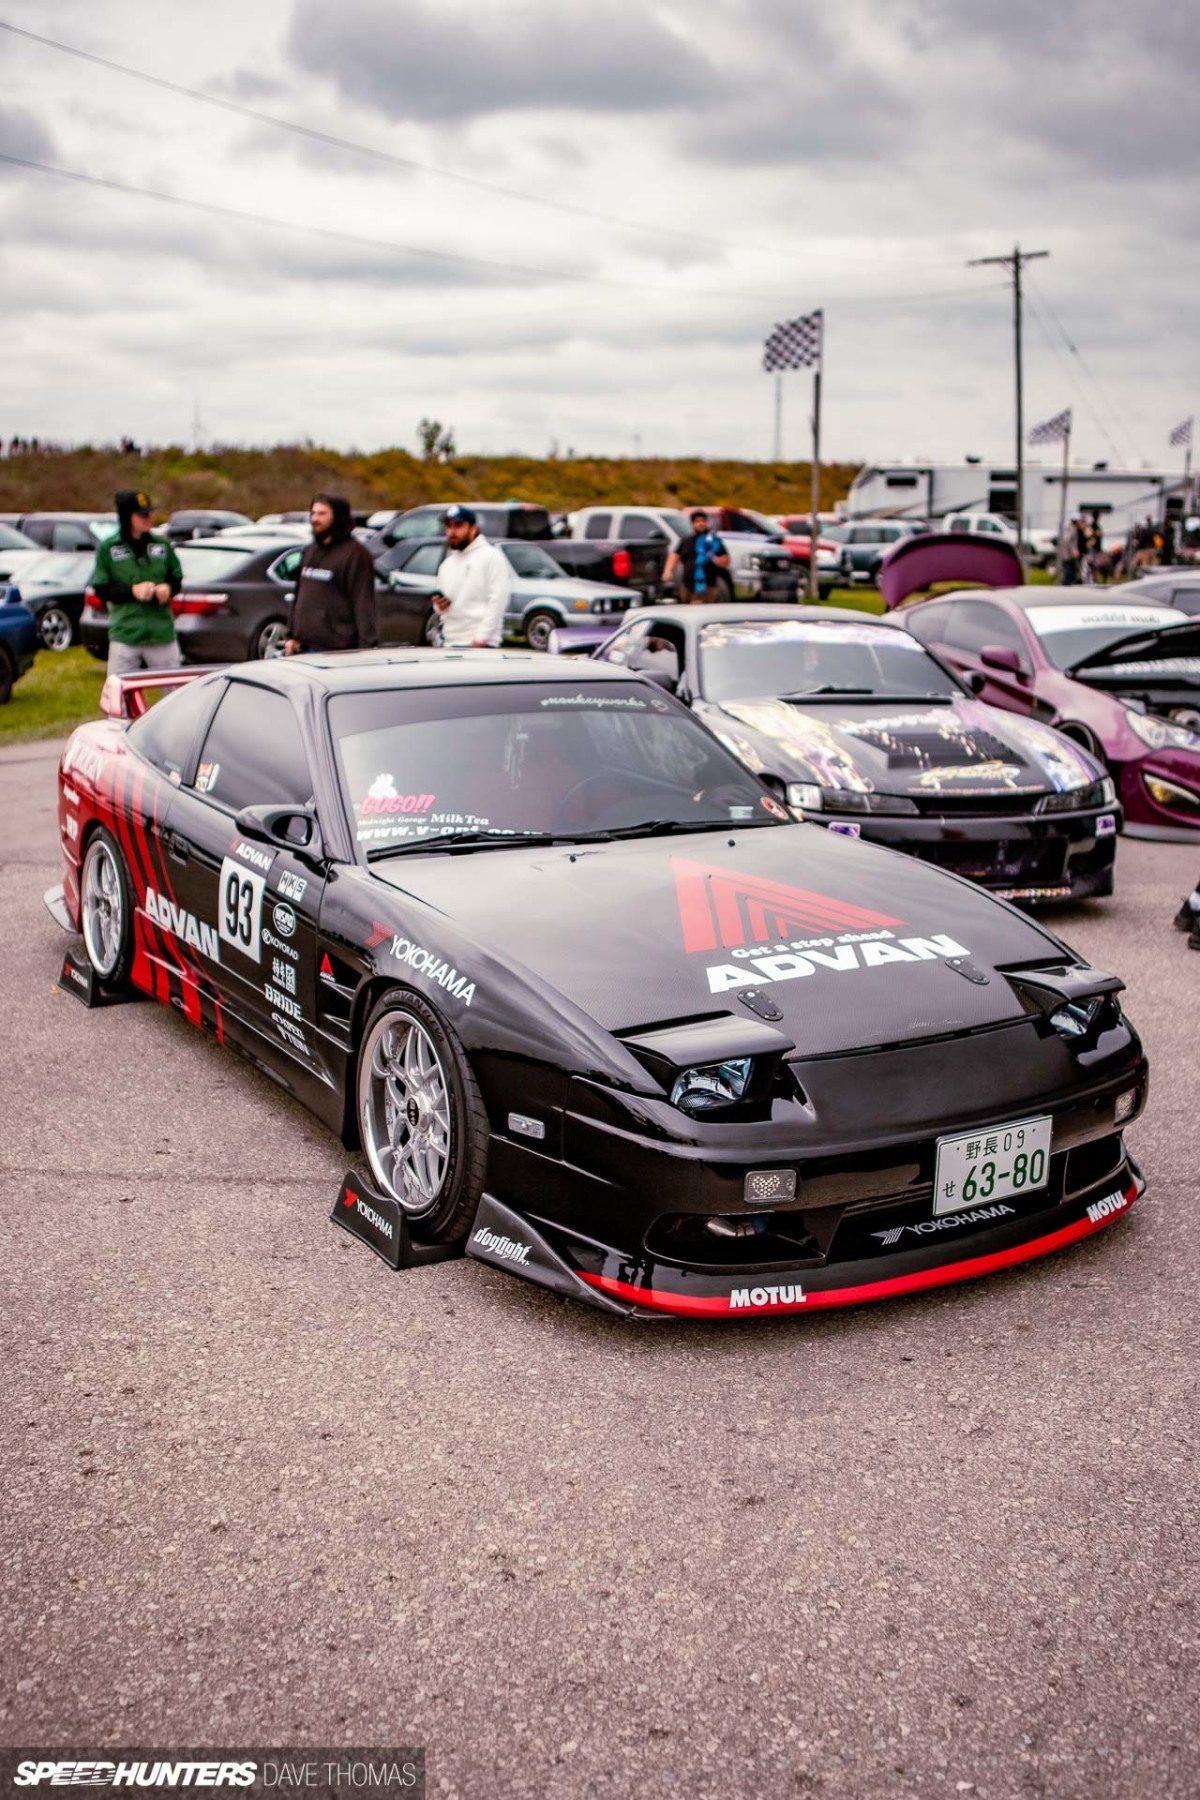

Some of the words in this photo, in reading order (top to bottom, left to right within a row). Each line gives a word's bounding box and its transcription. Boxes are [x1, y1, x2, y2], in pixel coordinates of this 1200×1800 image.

[541, 693, 646, 708] monkeyworks
[431, 813, 464, 824] Milk
[465, 814, 490, 826] Tea
[235, 842, 272, 871] ADVAN
[279, 870, 307, 897] HKS
[145, 886, 221, 963] ADVAN
[225, 871, 254, 947] 93
[731, 946, 773, 959] Get
[774, 944, 790, 952] a
[790, 937, 835, 951] step
[836, 929, 896, 944] ahead
[389, 934, 477, 1007] YOKOHAMA
[706, 934, 971, 994] ADVAN
[264, 983, 302, 1022] BRIDE
[1003, 1129, 1025, 1152] 09
[942, 1180, 957, 1198] せ
[962, 1149, 1045, 1202] 63-80
[356, 1198, 393, 1240] YOKOHAMA
[905, 1203, 1016, 1236] YOKOHAMA
[1086, 1190, 1128, 1223] MOTUL
[729, 1285, 807, 1309] MOTUL
